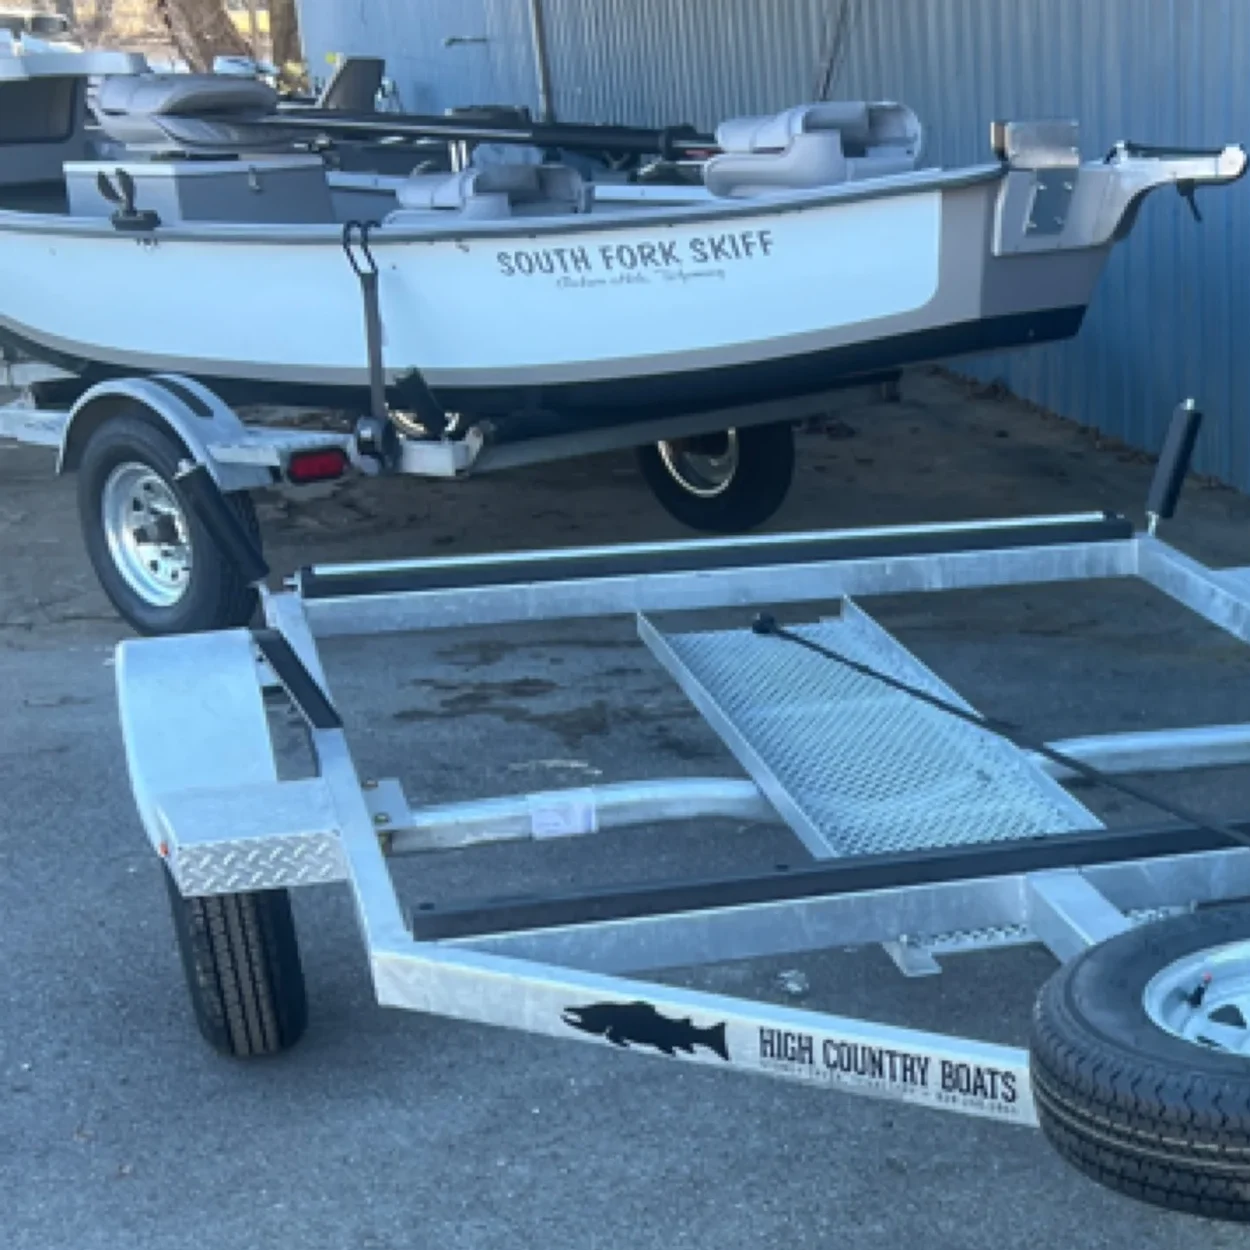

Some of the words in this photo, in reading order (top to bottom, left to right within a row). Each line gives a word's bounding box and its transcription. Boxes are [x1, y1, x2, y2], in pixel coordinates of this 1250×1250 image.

[498, 246, 592, 276] SOUTH
[600, 241, 681, 270] FORK
[690, 230, 774, 263] SKIFF
[759, 1027, 813, 1064] HIGH
[823, 1039, 930, 1086] COUNTRY
[941, 1061, 1016, 1103] BOATS
